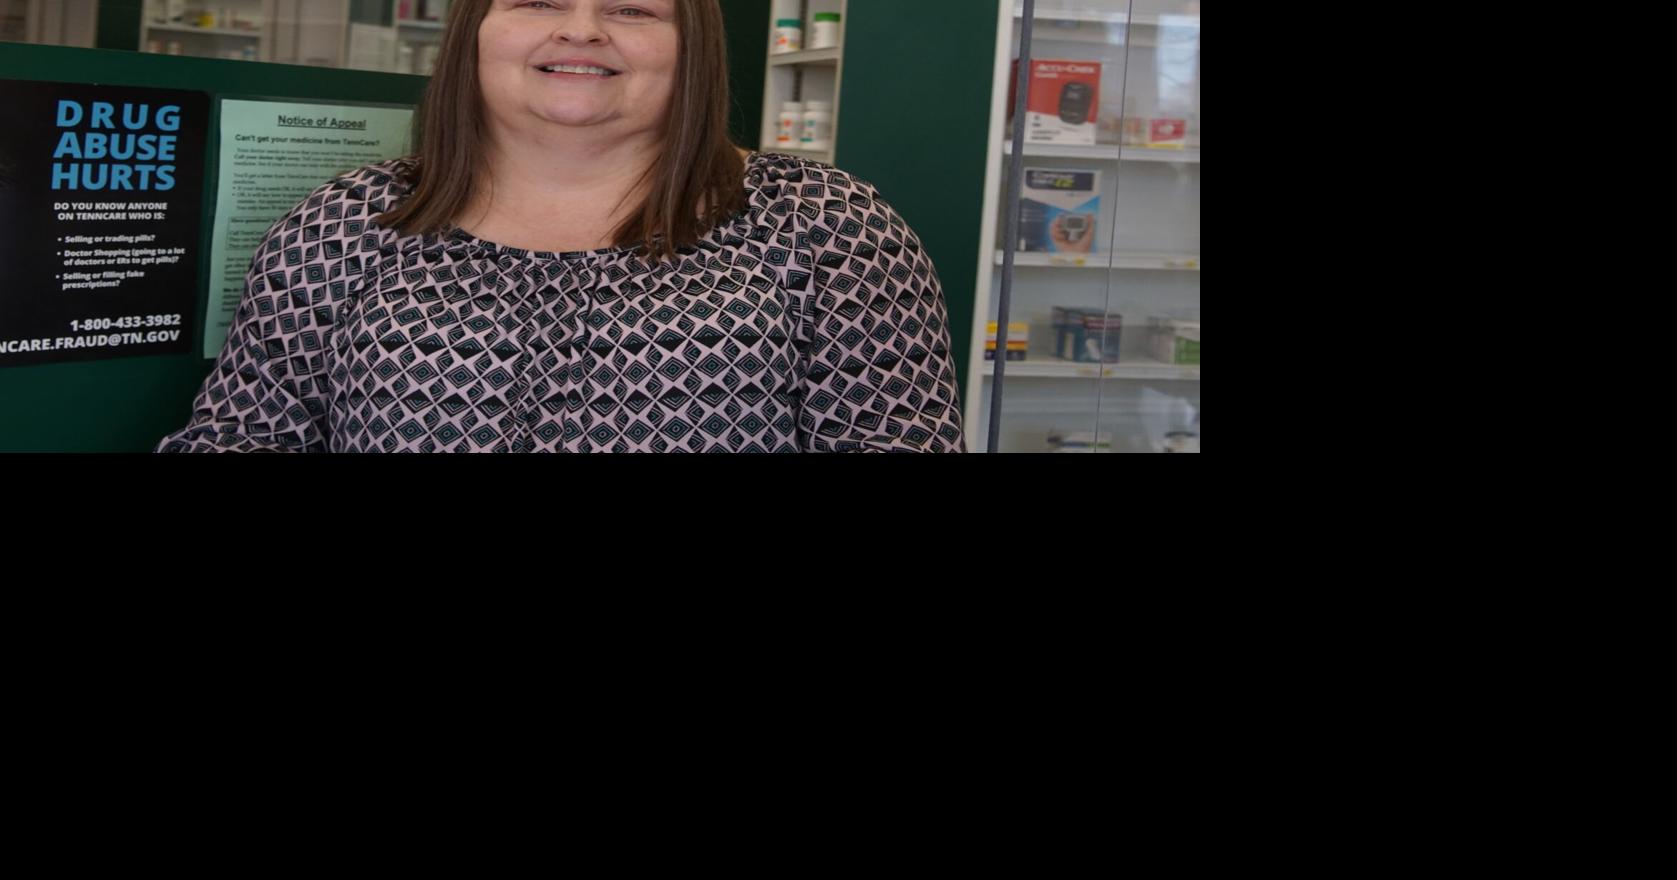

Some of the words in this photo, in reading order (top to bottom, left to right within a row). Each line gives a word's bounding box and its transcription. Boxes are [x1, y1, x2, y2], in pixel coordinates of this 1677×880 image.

[56, 100, 181, 131] DRUG
[277, 115, 314, 127] Notice
[316, 117, 328, 128] of
[330, 118, 367, 130] Appeal
[235, 134, 256, 142] Can't
[257, 136, 270, 144] get
[290, 137, 323, 145] medicine
[343, 138, 380, 147] TennCare?
[53, 131, 177, 161] ABUSE
[51, 163, 176, 190] HURTS
[54, 202, 69, 210] DO
[71, 202, 93, 210] YOU
[95, 202, 126, 210] KNOW
[127, 202, 168, 210] ANYONE
[58, 212, 74, 220] ON
[76, 212, 126, 220] TENNCARE
[128, 212, 152, 220] WHO
[153, 212, 165, 220] IS:
[65, 236, 93, 244] Selling
[104, 235, 134, 243] trading
[135, 234, 155, 243] pills?
[94, 249, 131, 257] Shopping
[131, 248, 157, 256] (going
[74, 258, 105, 266] doctors
[142, 257, 155, 265] get
[103, 271, 126, 279] filling
[127, 270, 145, 278] fake
[63, 280, 120, 290] prescriptions?
[70, 314, 181, 331] 1-800-433-3982
